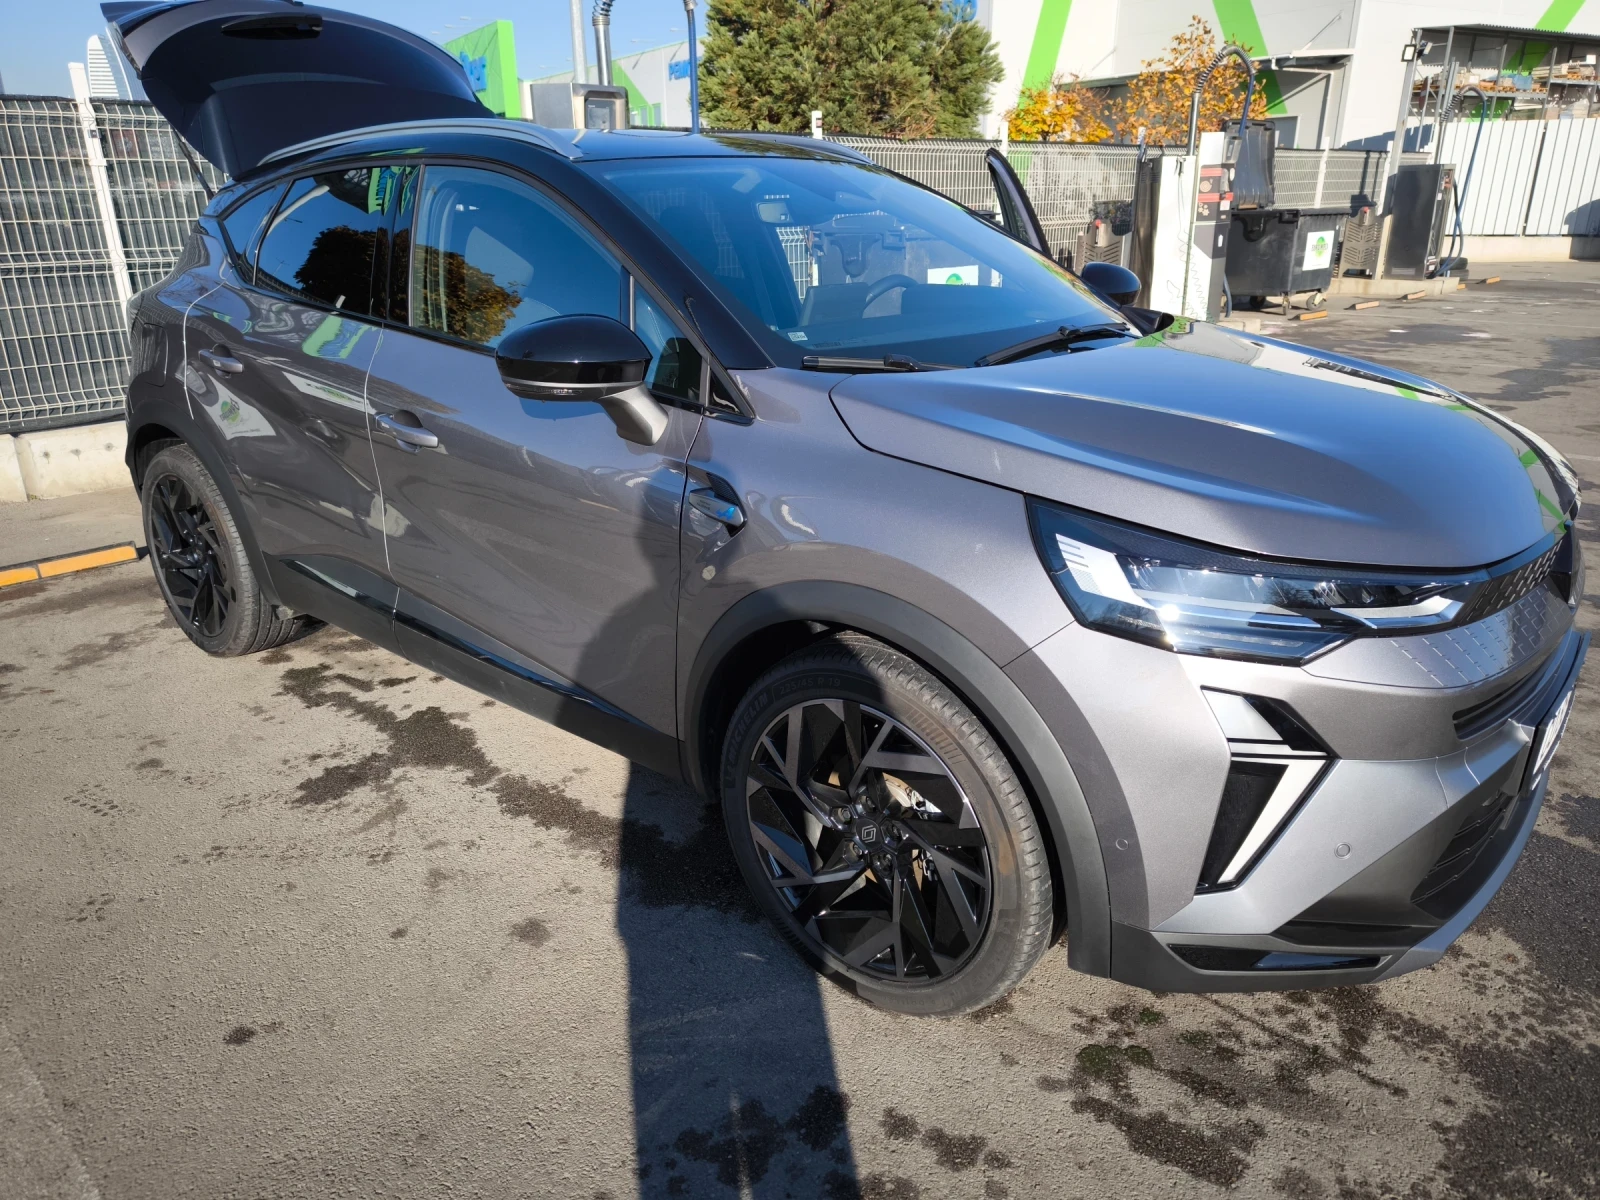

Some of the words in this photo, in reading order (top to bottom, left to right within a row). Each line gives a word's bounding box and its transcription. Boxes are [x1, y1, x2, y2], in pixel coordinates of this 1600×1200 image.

[779, 677, 814, 695] 225/45
[817, 677, 825, 686] R
[828, 677, 841, 688] 19
[727, 691, 769, 763] MICHELIN
